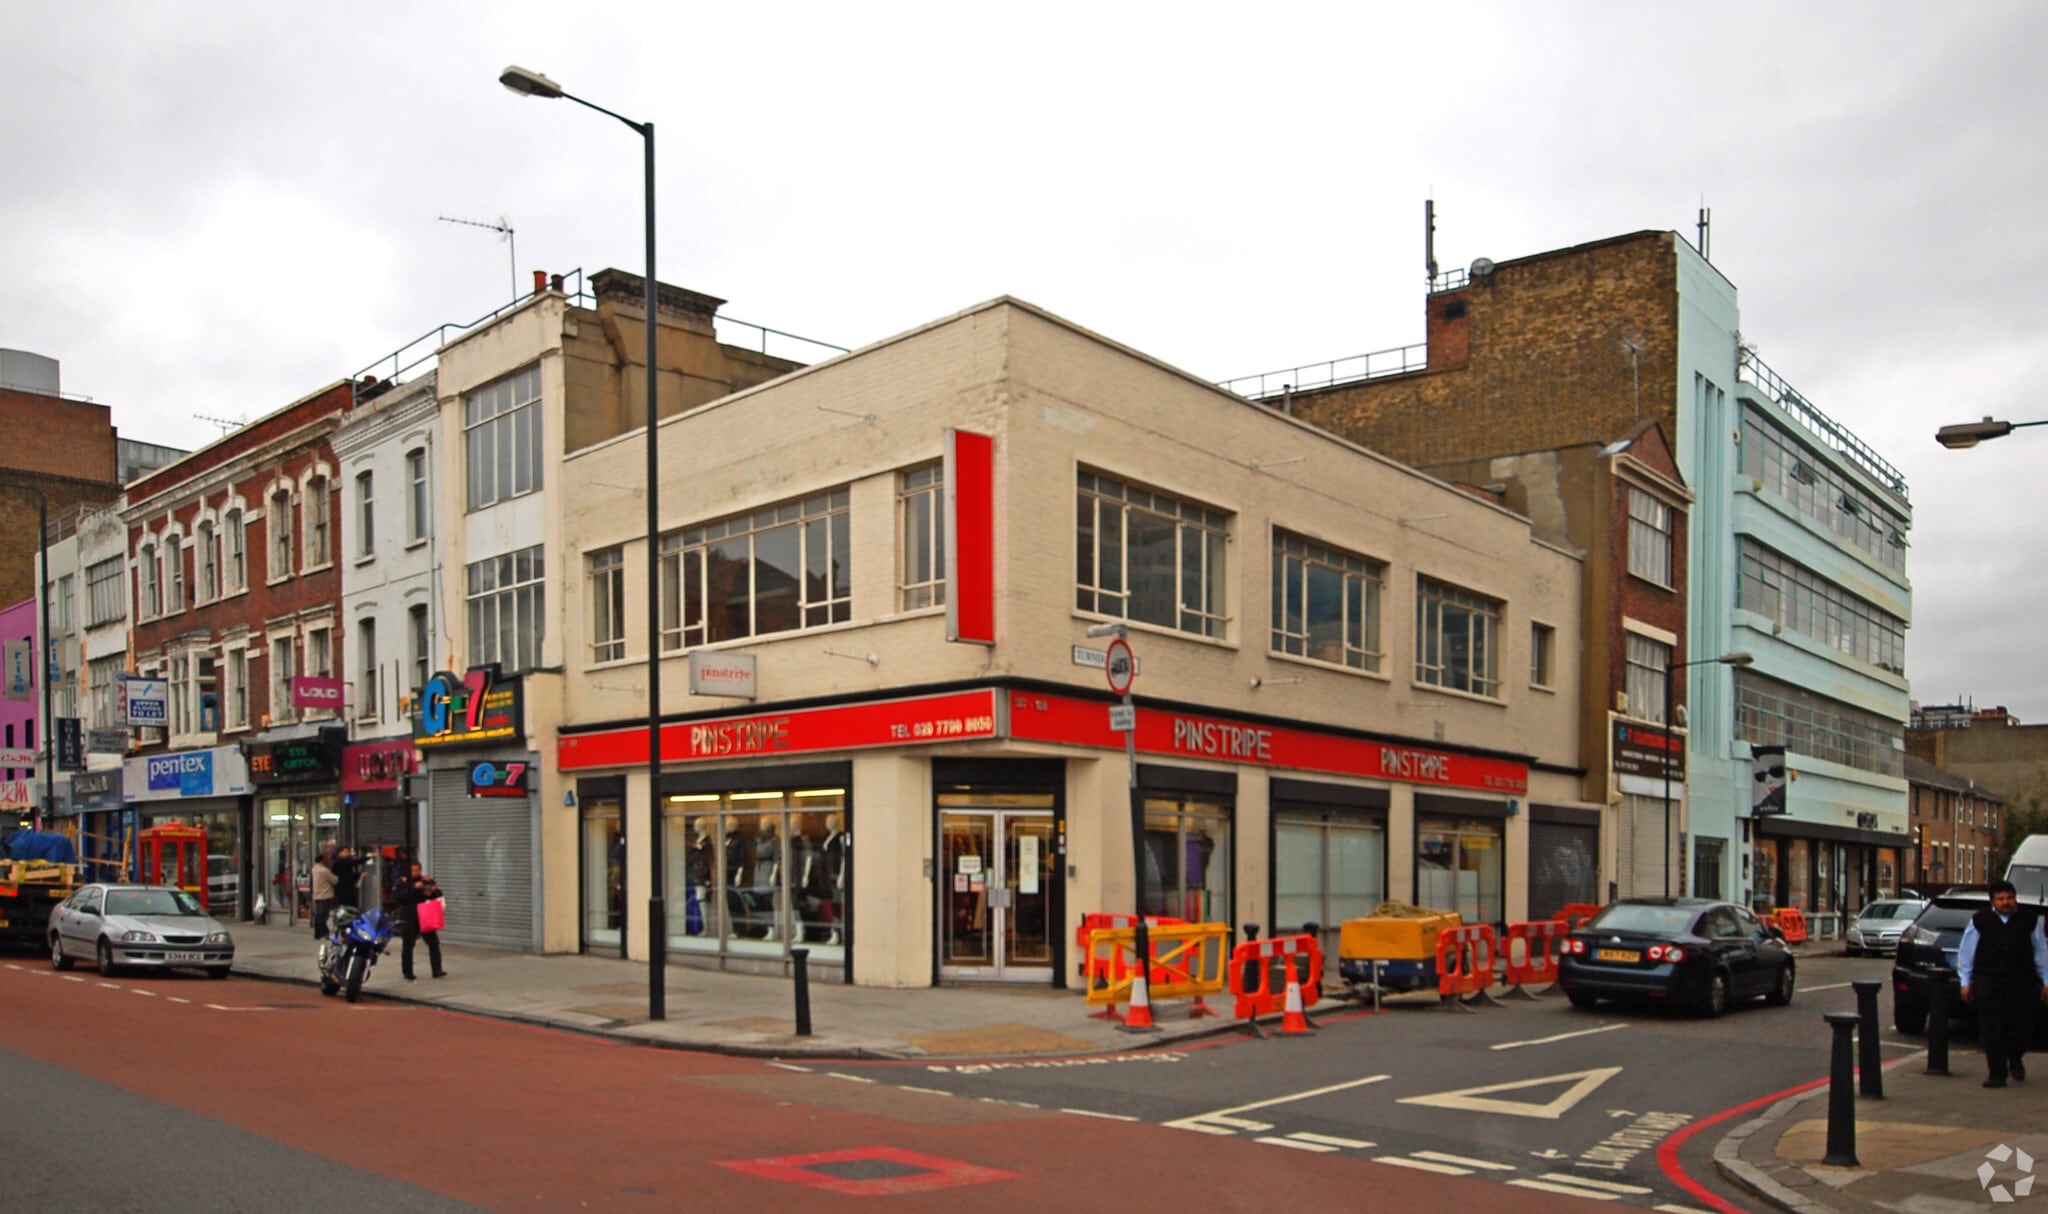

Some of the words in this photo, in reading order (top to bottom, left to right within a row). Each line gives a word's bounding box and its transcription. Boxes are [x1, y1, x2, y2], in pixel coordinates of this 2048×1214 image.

[701, 665, 752, 682] pinstripe
[299, 687, 338, 698] LOUD
[691, 718, 790, 756] PINSTRIPE
[890, 723, 910, 738] TEL
[1174, 718, 1272, 760] PINSTRIPE
[150, 756, 205, 781] pentex
[252, 755, 272, 772] EYE
[472, 762, 525, 786] G-7
[1380, 747, 1449, 781] PINSTRIPE
